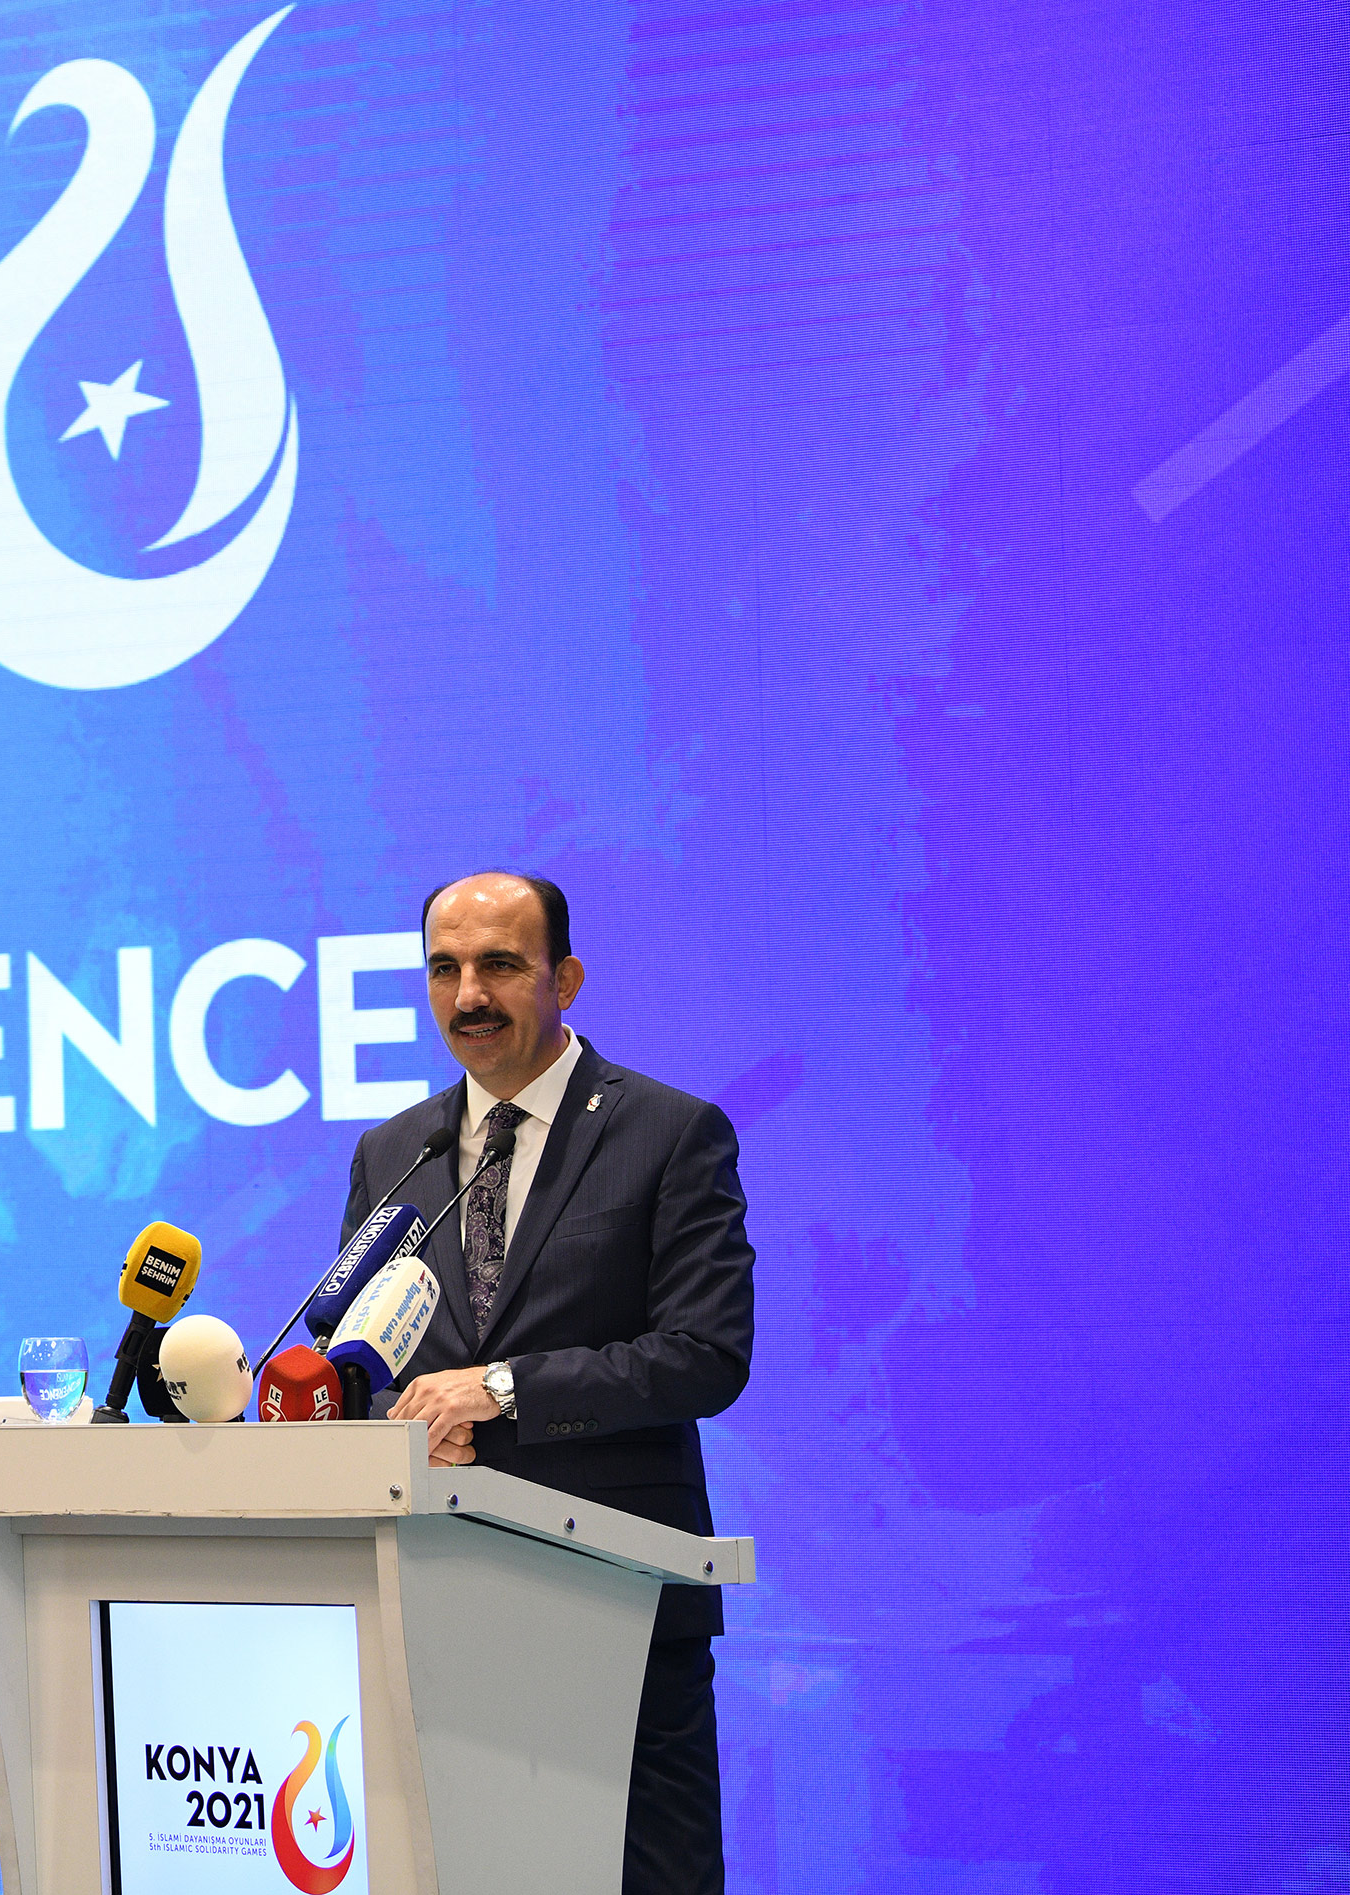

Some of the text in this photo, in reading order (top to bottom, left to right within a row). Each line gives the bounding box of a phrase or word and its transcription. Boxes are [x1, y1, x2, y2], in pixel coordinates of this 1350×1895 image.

[376, 1208, 398, 1221] 24
[270, 1389, 281, 1403] LE
[315, 1390, 328, 1404] LE
[145, 1744, 263, 1784] KONYA
[186, 1790, 265, 1830] 2021
[228, 1836, 267, 1847] OYUNLARI
[149, 1842, 267, 1857] 5th ISLAMIC SOLIDARITY GAMES
